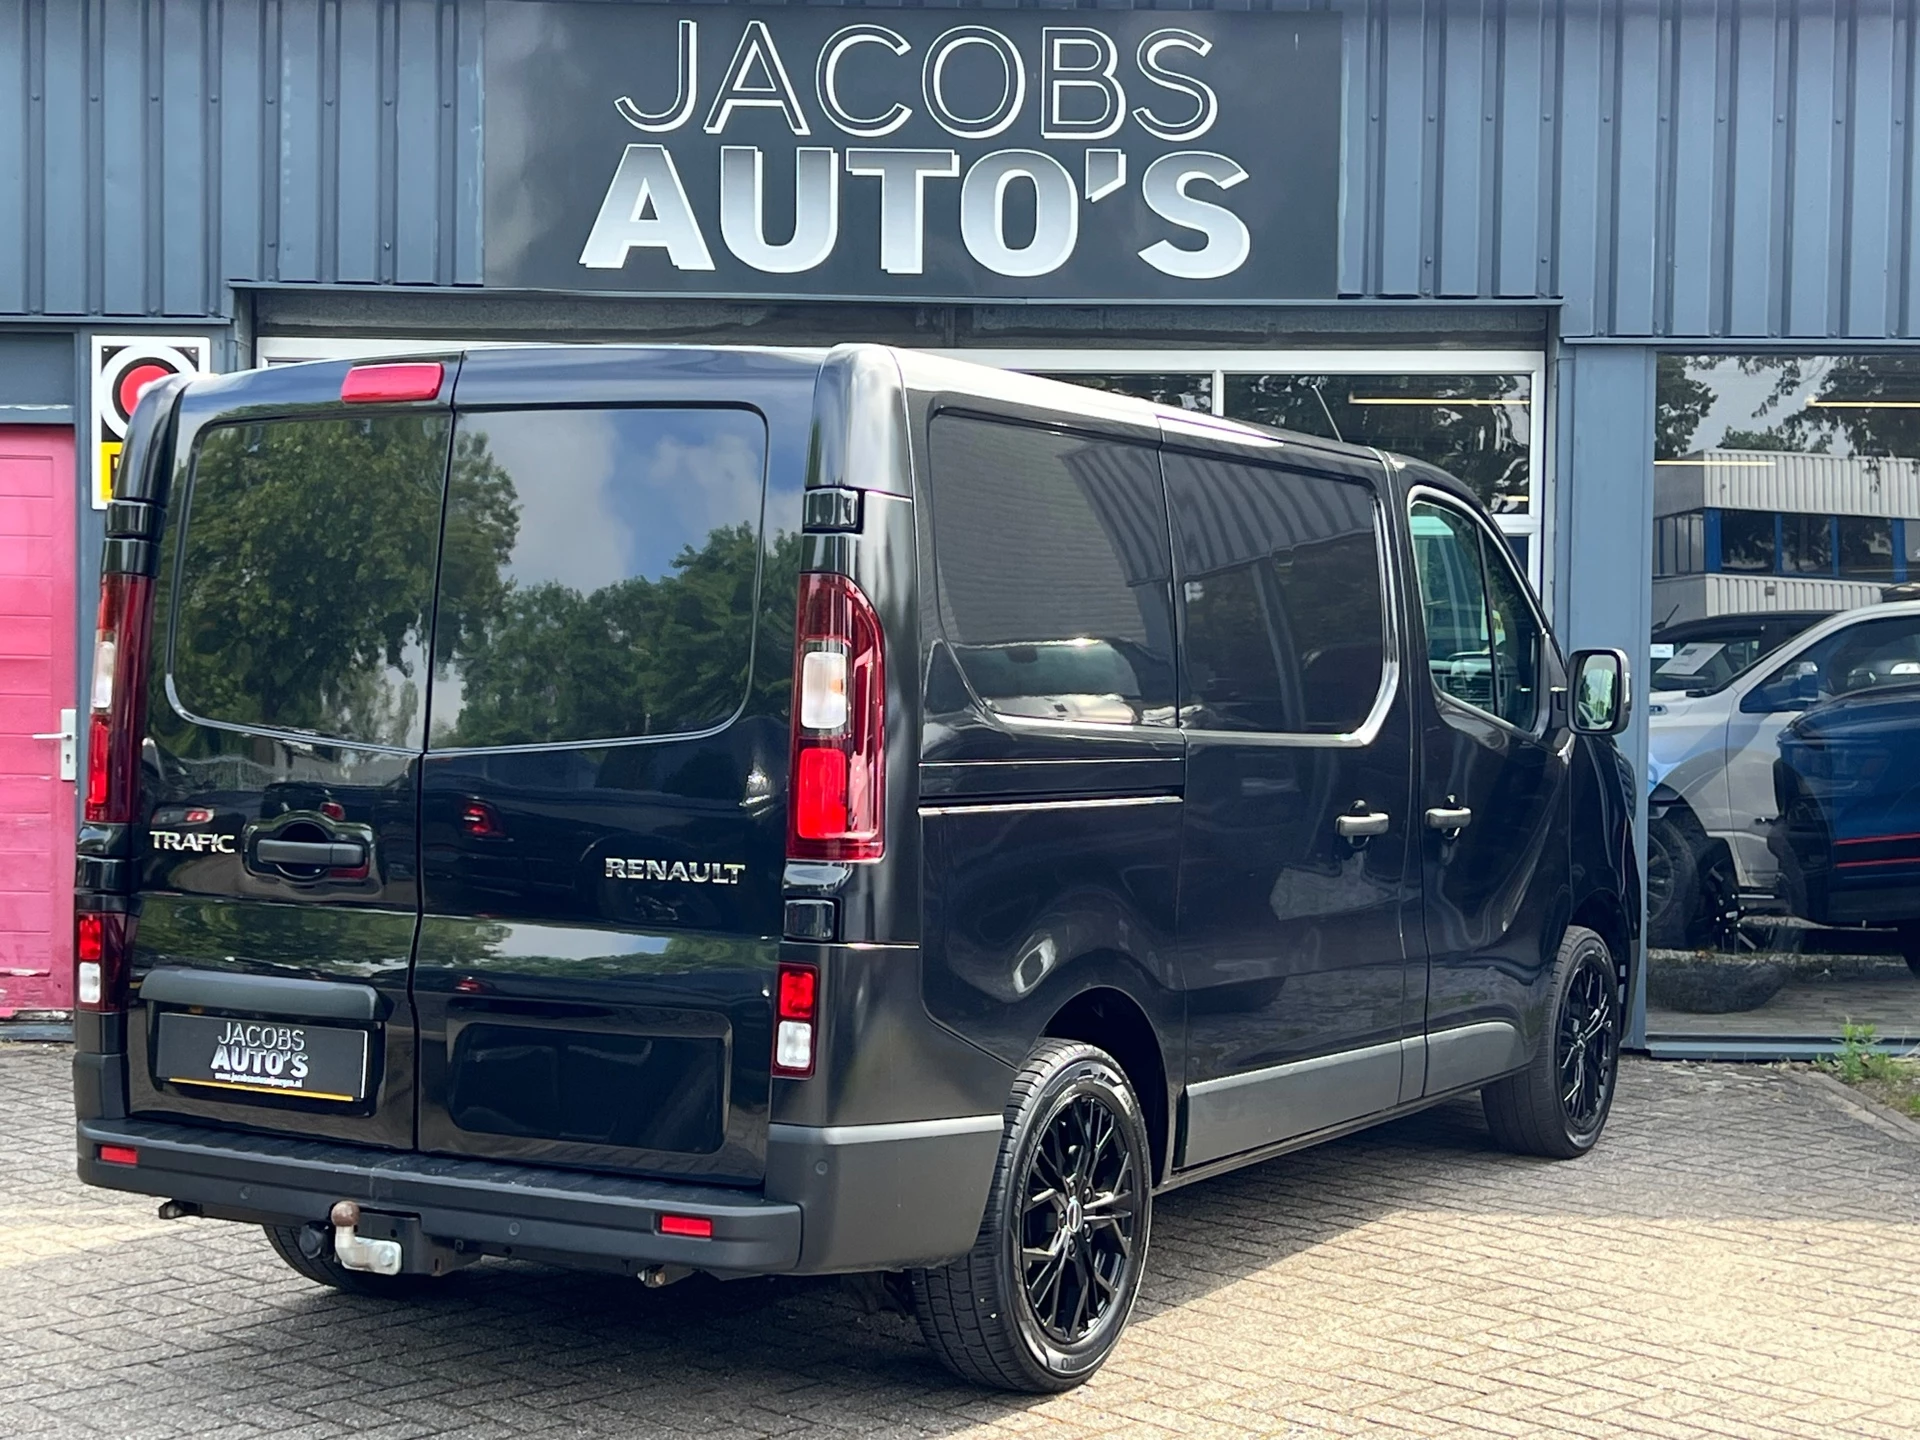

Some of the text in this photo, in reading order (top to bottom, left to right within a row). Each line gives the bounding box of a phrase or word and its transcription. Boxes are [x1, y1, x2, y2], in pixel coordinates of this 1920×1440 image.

[615, 20, 1218, 141] JACOBS
[579, 144, 1251, 279] AUTO'S
[149, 830, 236, 854] TRAFIC
[605, 857, 746, 885] RENAULT
[217, 1021, 306, 1052] JACOBS
[210, 1045, 309, 1078] AUTO'S
